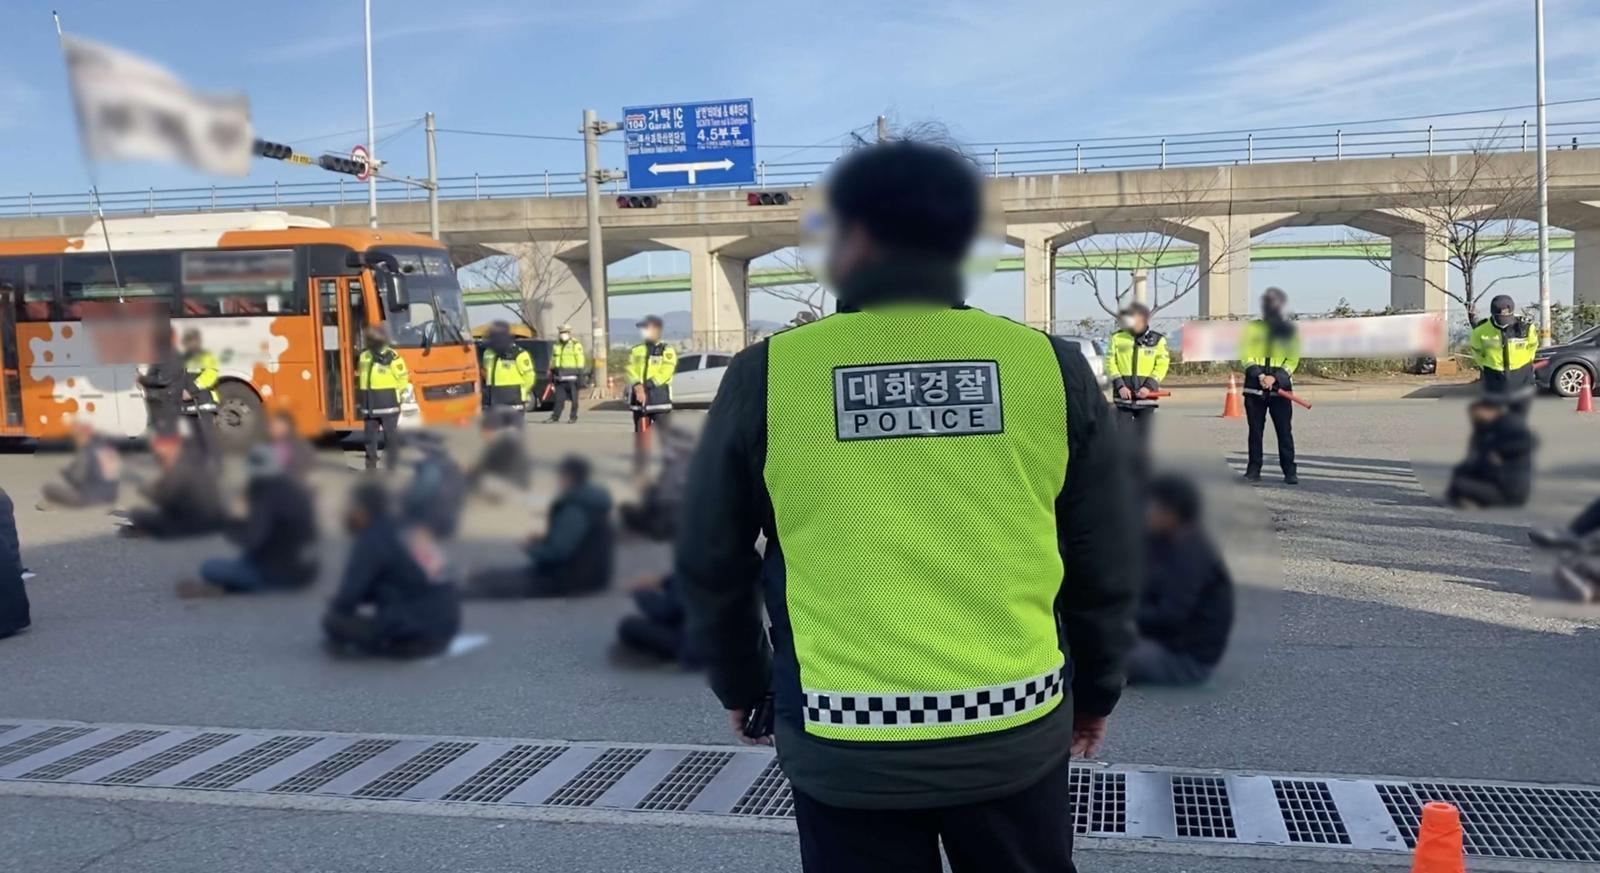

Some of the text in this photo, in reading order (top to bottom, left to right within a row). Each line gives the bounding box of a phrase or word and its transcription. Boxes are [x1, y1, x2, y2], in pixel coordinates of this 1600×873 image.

[648, 107, 683, 122] 가락 IC
[628, 119, 643, 129] 104
[648, 120, 683, 130] Garak IC
[848, 369, 986, 406] 대화경찰
[854, 408, 985, 433] POLICE
